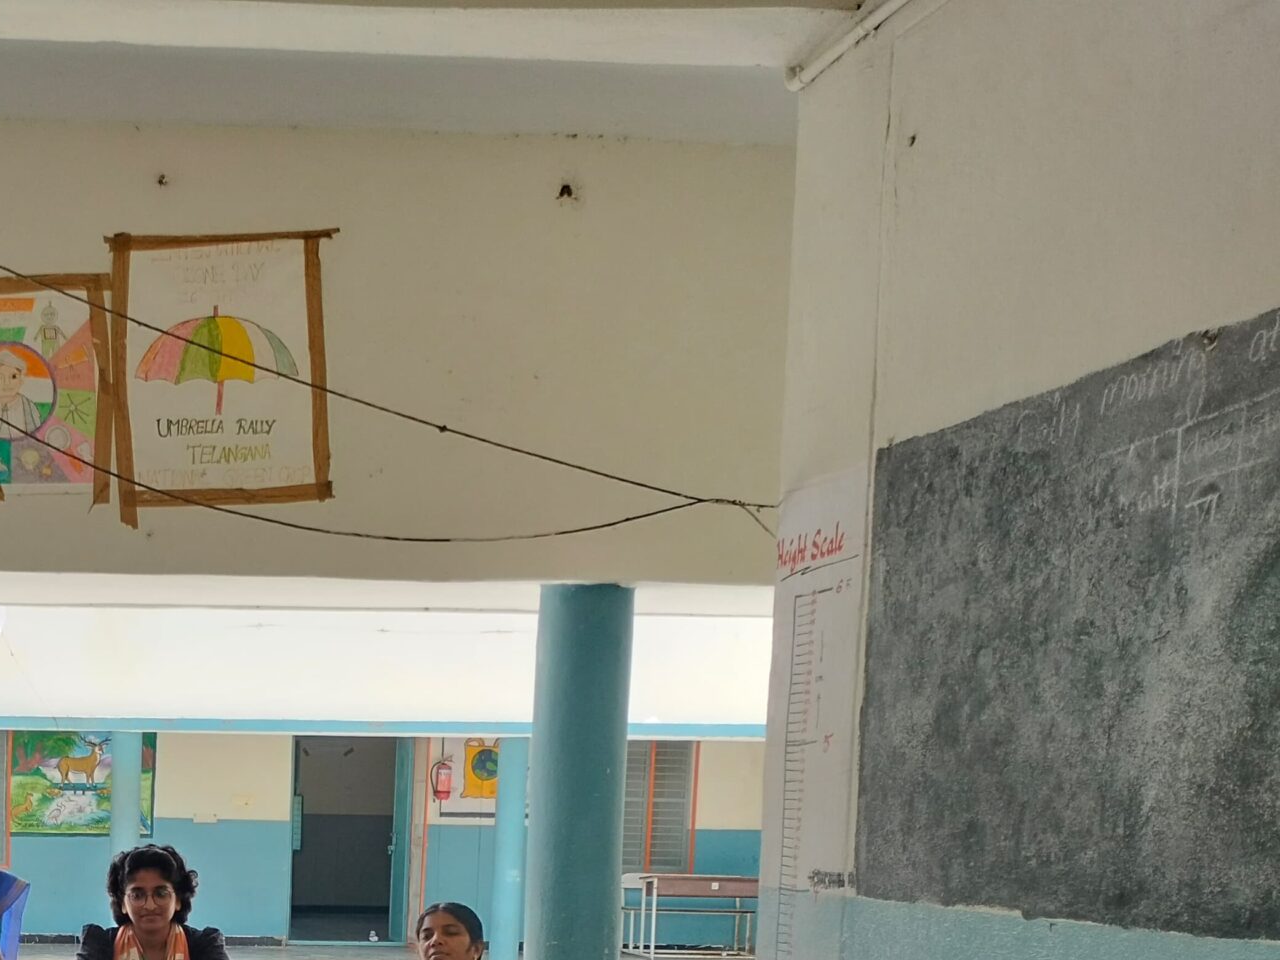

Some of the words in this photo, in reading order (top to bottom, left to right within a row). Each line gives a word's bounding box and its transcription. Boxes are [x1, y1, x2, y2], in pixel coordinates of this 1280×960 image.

[156, 418, 224, 438] UMBRELLA
[236, 418, 277, 436] RALLY
[186, 443, 272, 465] TELANGANA
[776, 532, 808, 576] Height
[811, 520, 845, 561] Scale
